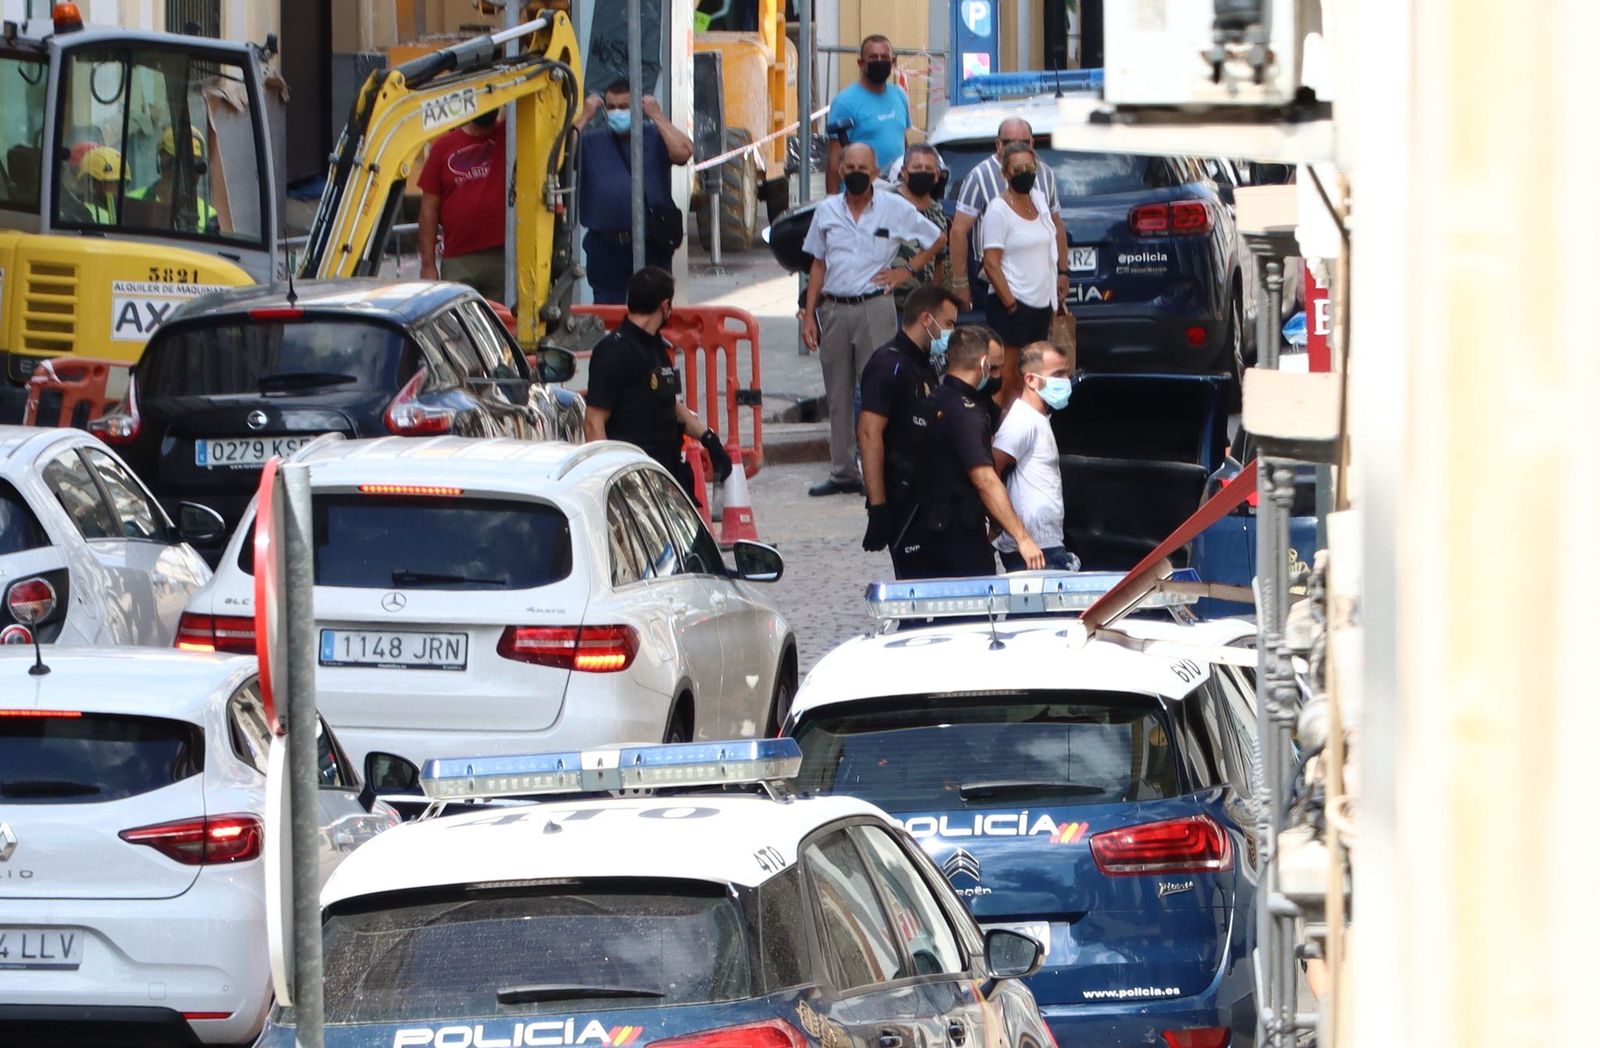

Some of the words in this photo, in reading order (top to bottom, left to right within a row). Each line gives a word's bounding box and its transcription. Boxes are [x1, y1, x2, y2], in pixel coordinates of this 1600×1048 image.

[423, 88, 476, 126] AXOR
[1067, 249, 1093, 267] RZ
[1118, 252, 1168, 265] @policia
[148, 267, 199, 284] 5821
[114, 283, 160, 293] ALQUILER
[176, 285, 224, 296] MAQUINA
[212, 441, 265, 461] 0279
[344, 635, 403, 659] 1148
[413, 637, 460, 660] JRN
[22, 933, 75, 958] LLV
[1083, 987, 1181, 998] www.policia.es
[393, 1017, 612, 1048] POLICÍA
